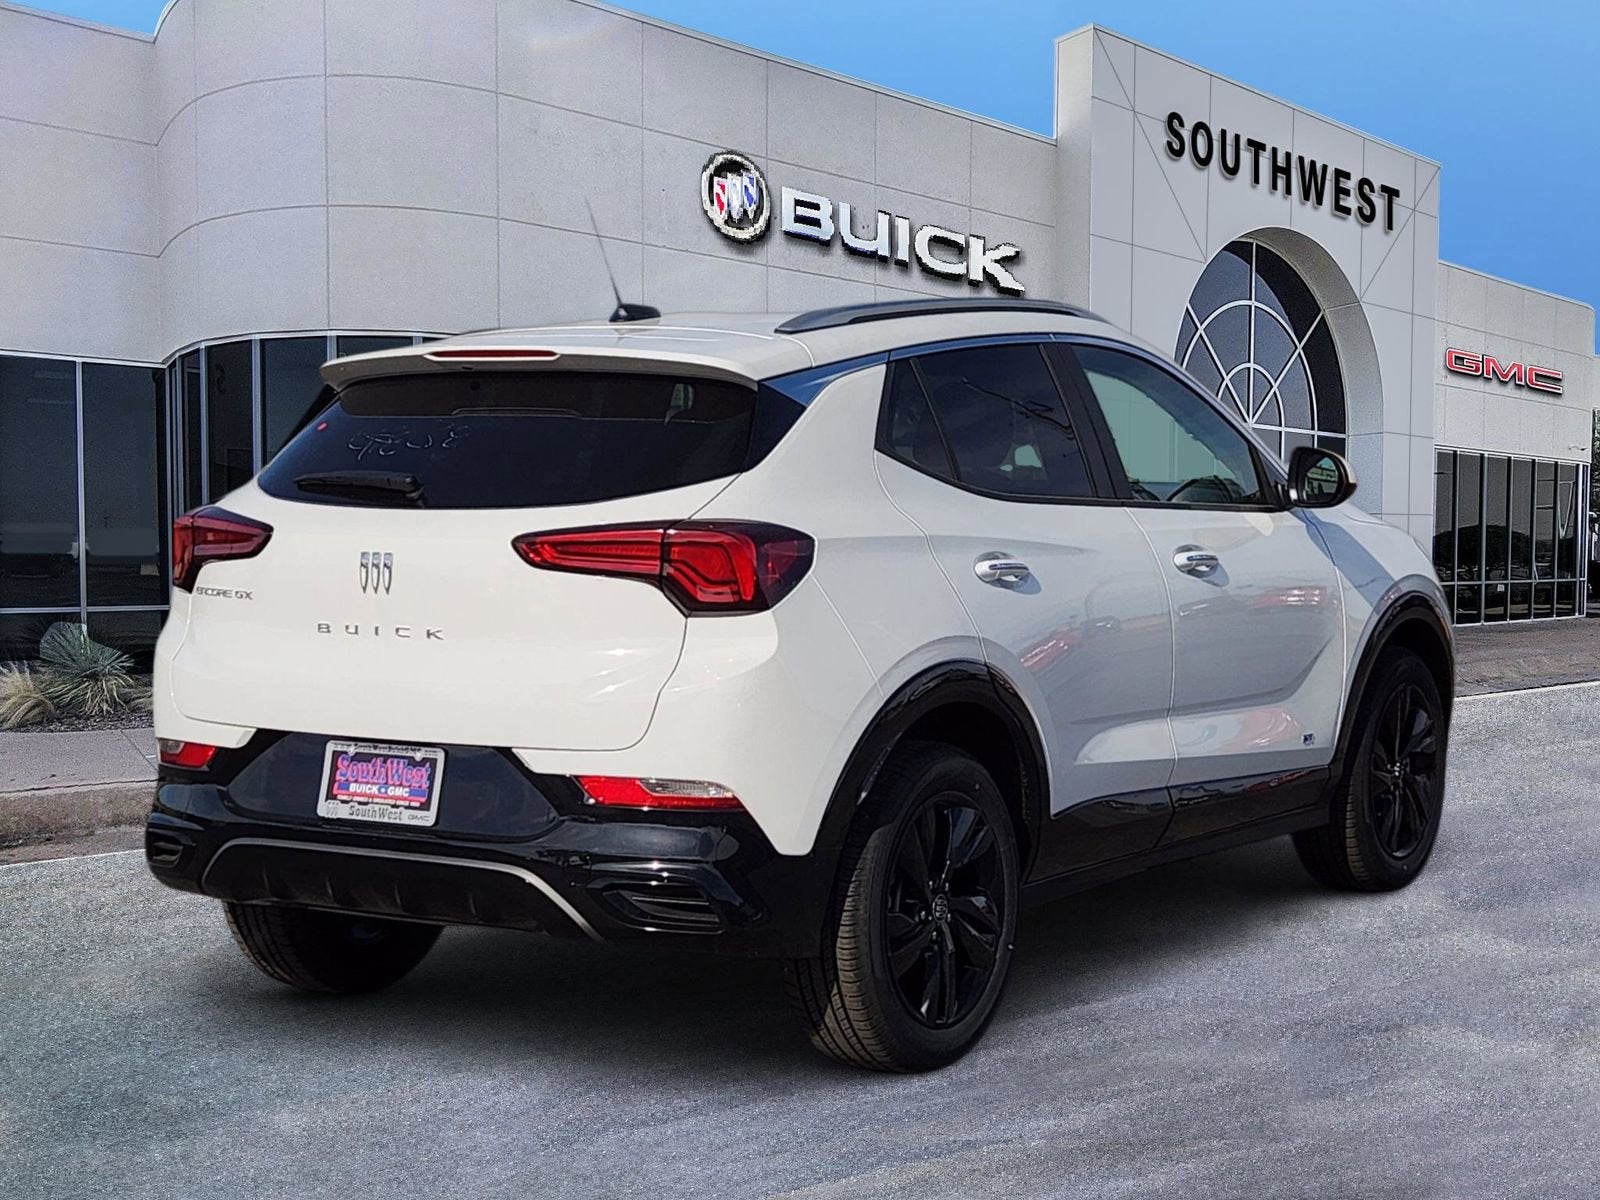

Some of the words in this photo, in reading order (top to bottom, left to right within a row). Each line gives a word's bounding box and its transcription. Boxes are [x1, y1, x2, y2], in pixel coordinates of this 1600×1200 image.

[1166, 111, 1400, 231] SOUTHWEST
[782, 186, 1024, 296] BUICK
[1446, 347, 1563, 394] GMC
[235, 590, 253, 600] GX
[317, 623, 444, 640] BUICK
[349, 782, 379, 794] BUICK
[387, 785, 410, 797] GMC
